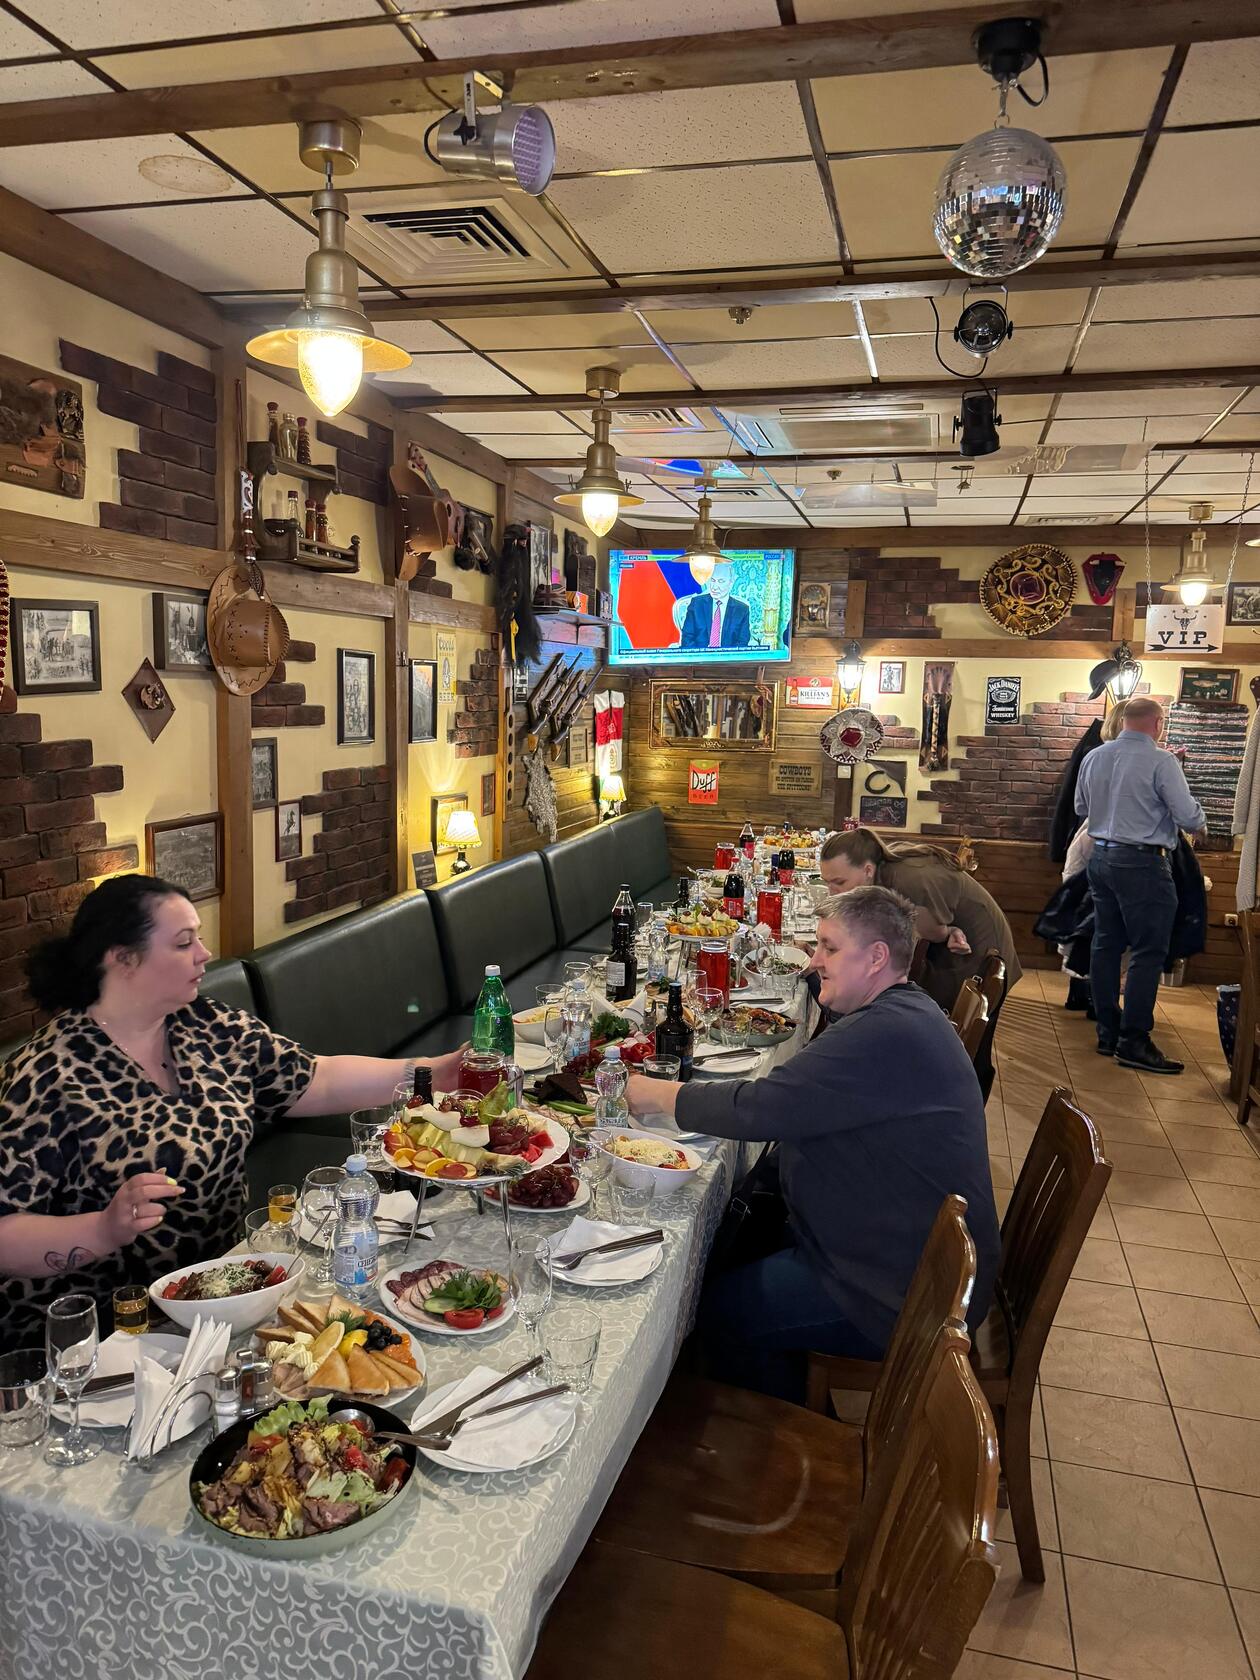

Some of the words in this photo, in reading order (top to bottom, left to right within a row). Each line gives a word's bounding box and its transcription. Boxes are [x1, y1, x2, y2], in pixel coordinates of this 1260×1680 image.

[1158, 631, 1207, 645] VIP
[779, 765, 812, 776] COWBOYS
[692, 770, 717, 793] Duff
